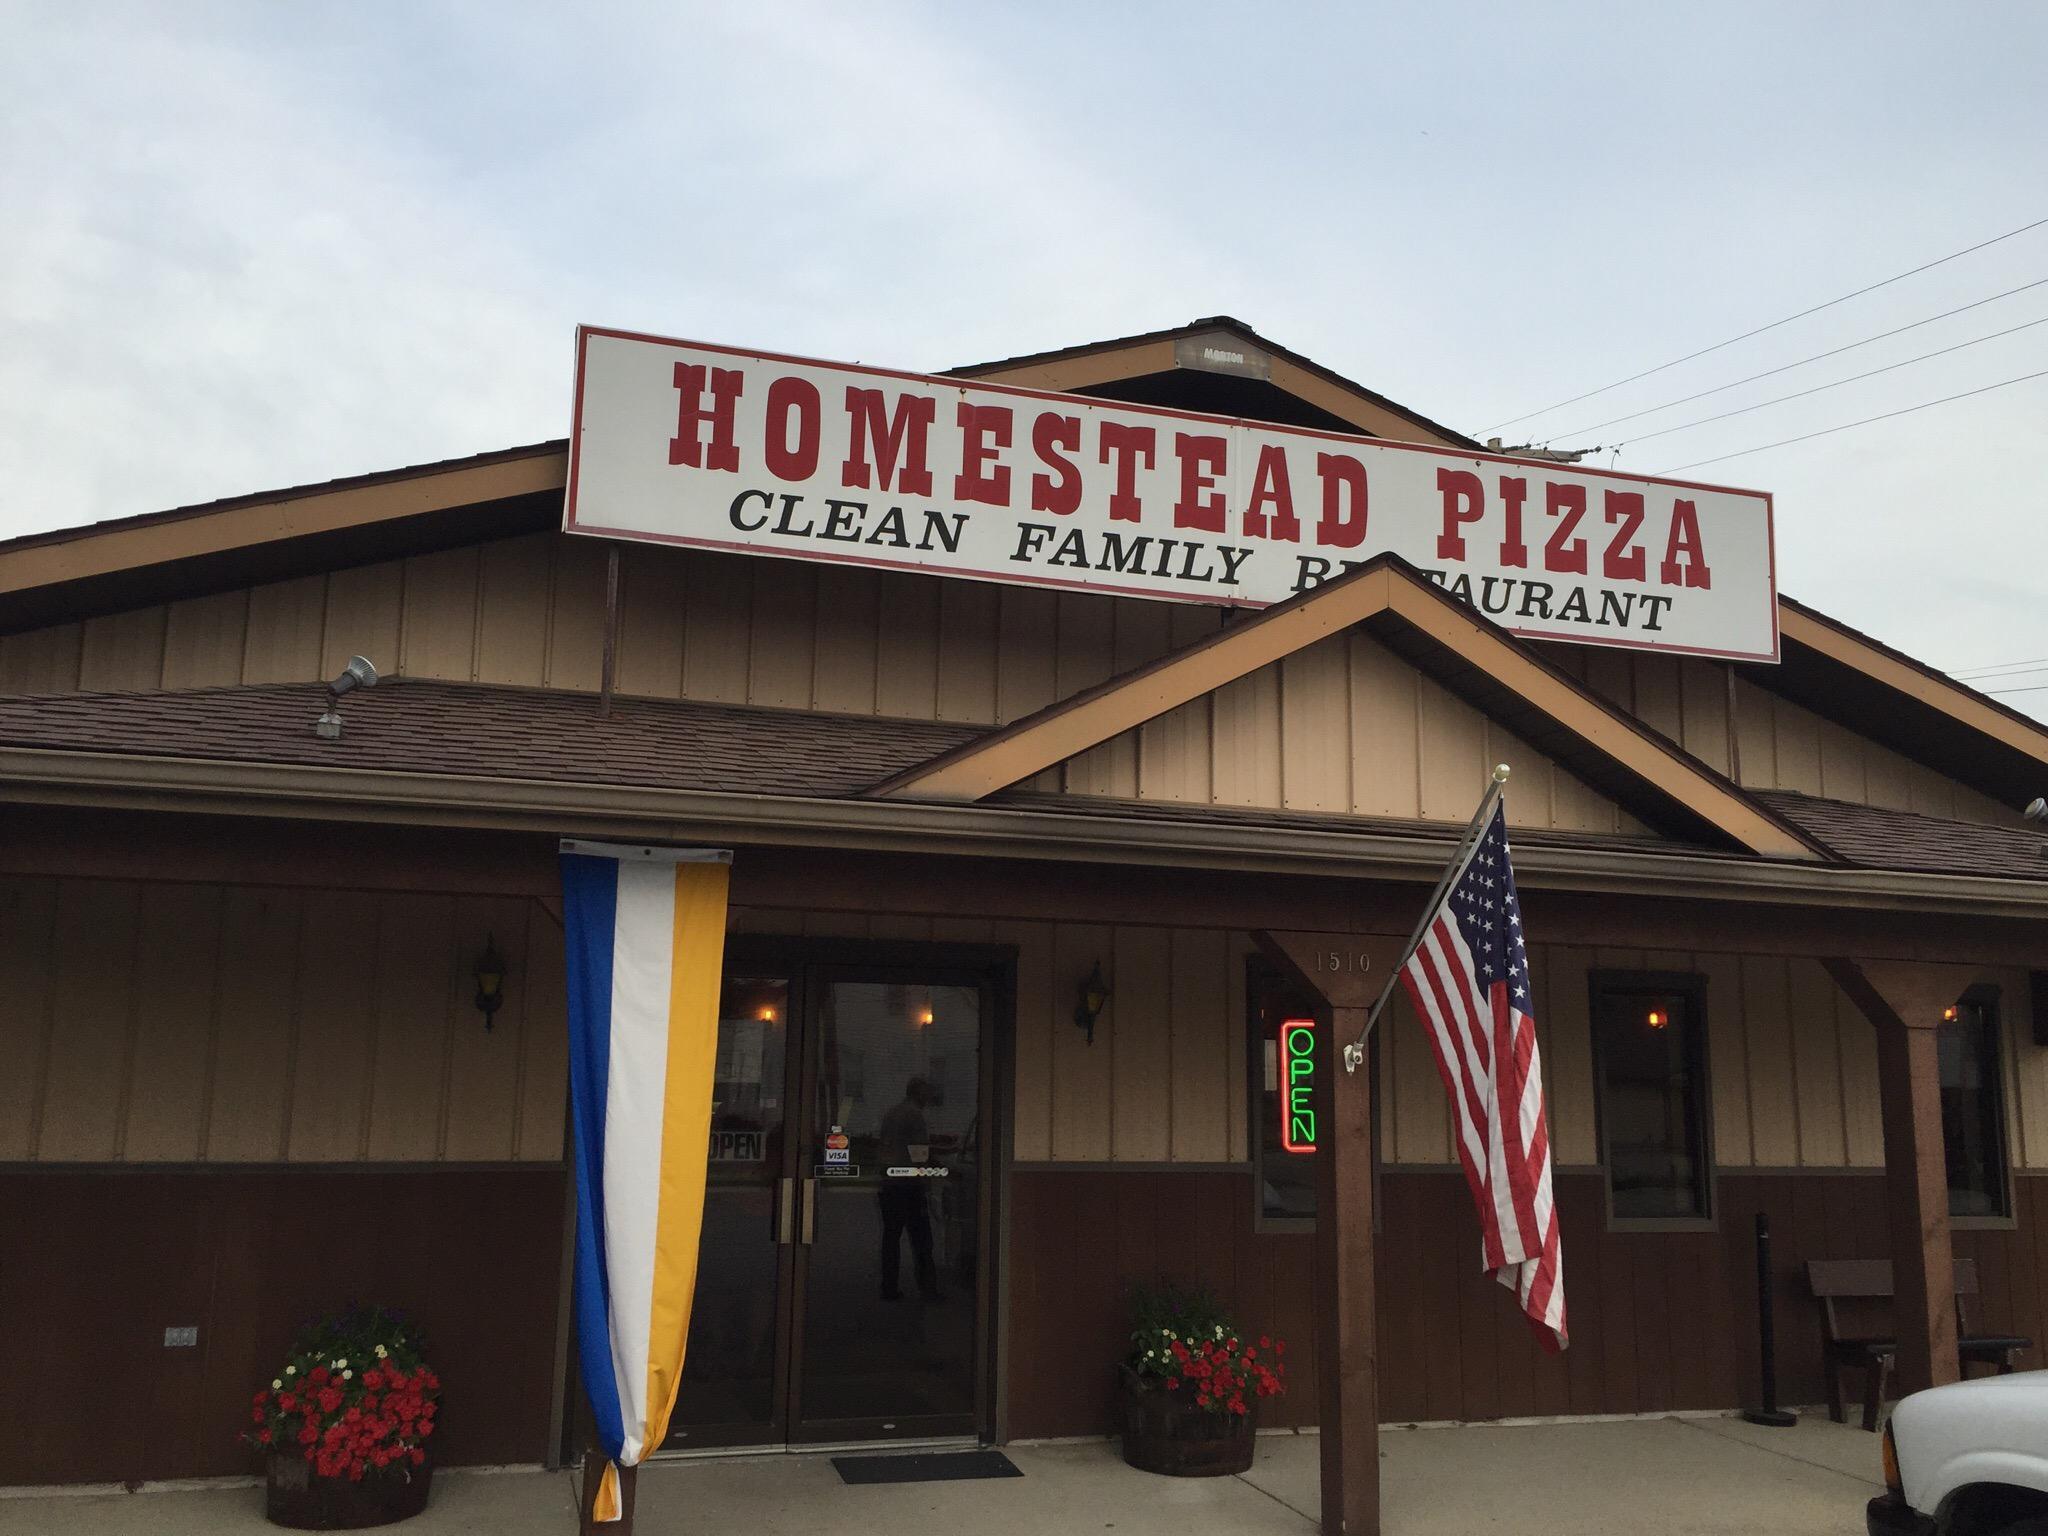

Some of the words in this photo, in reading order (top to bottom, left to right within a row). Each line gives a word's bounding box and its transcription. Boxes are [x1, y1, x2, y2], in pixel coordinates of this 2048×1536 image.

[668, 361, 1369, 549] HOMESTEAD
[1436, 467, 1710, 589] PIZZA
[729, 489, 971, 553] CLEAN
[1010, 522, 1255, 585] FAMILY
[1315, 951, 1370, 972] 1510
[1288, 1028, 1316, 1142] OPEN
[828, 1151, 848, 1161] VISA
